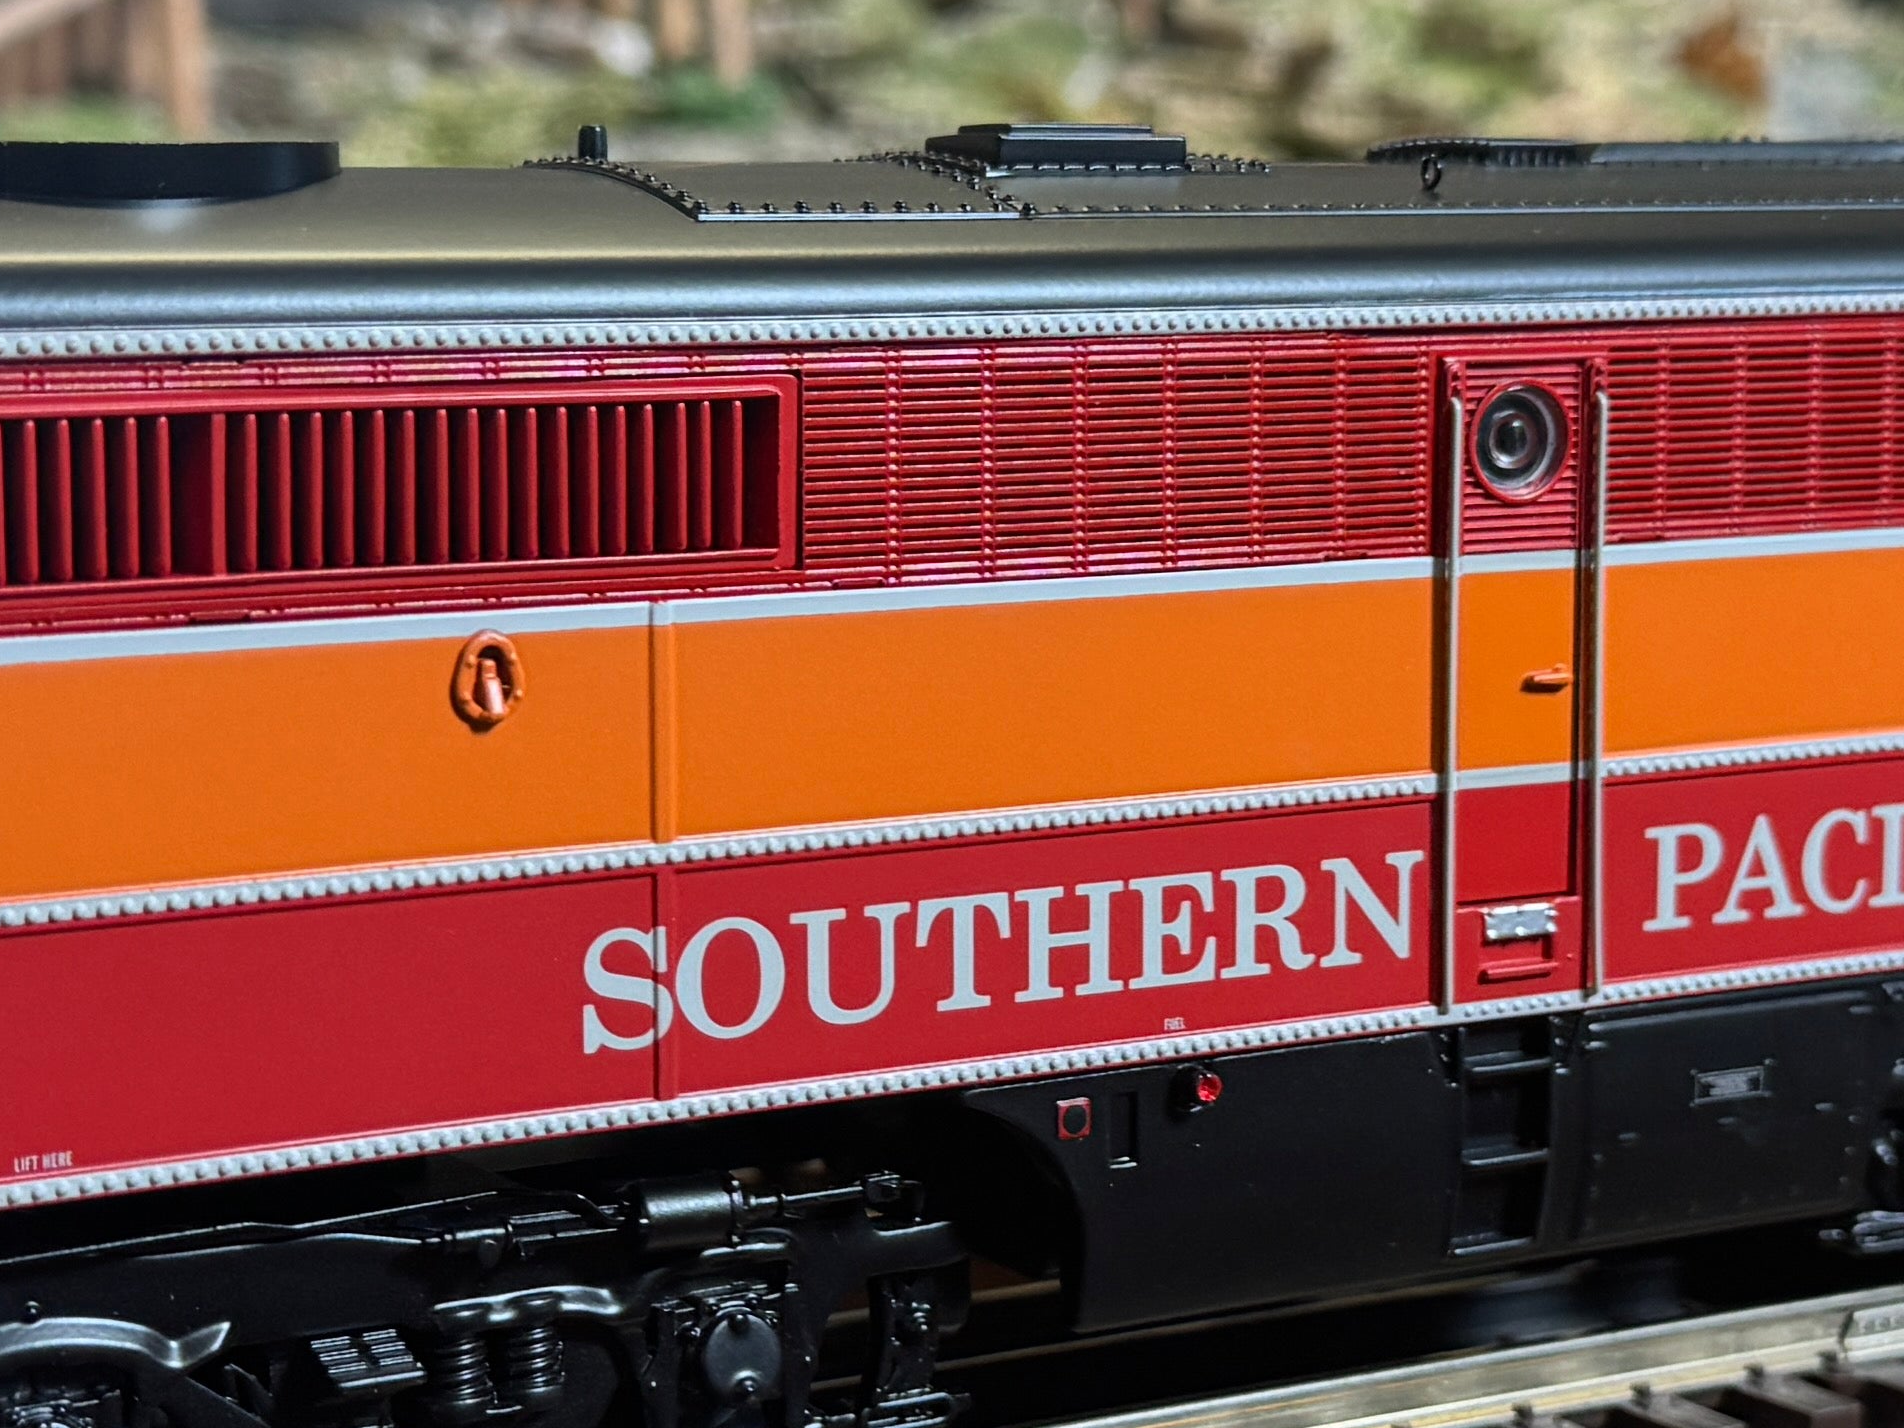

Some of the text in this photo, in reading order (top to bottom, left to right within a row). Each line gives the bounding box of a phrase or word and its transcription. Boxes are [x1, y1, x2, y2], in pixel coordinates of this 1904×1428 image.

[582, 849, 1426, 1056] SOUTHERN
[13, 1150, 73, 1173] LIFT HERE
